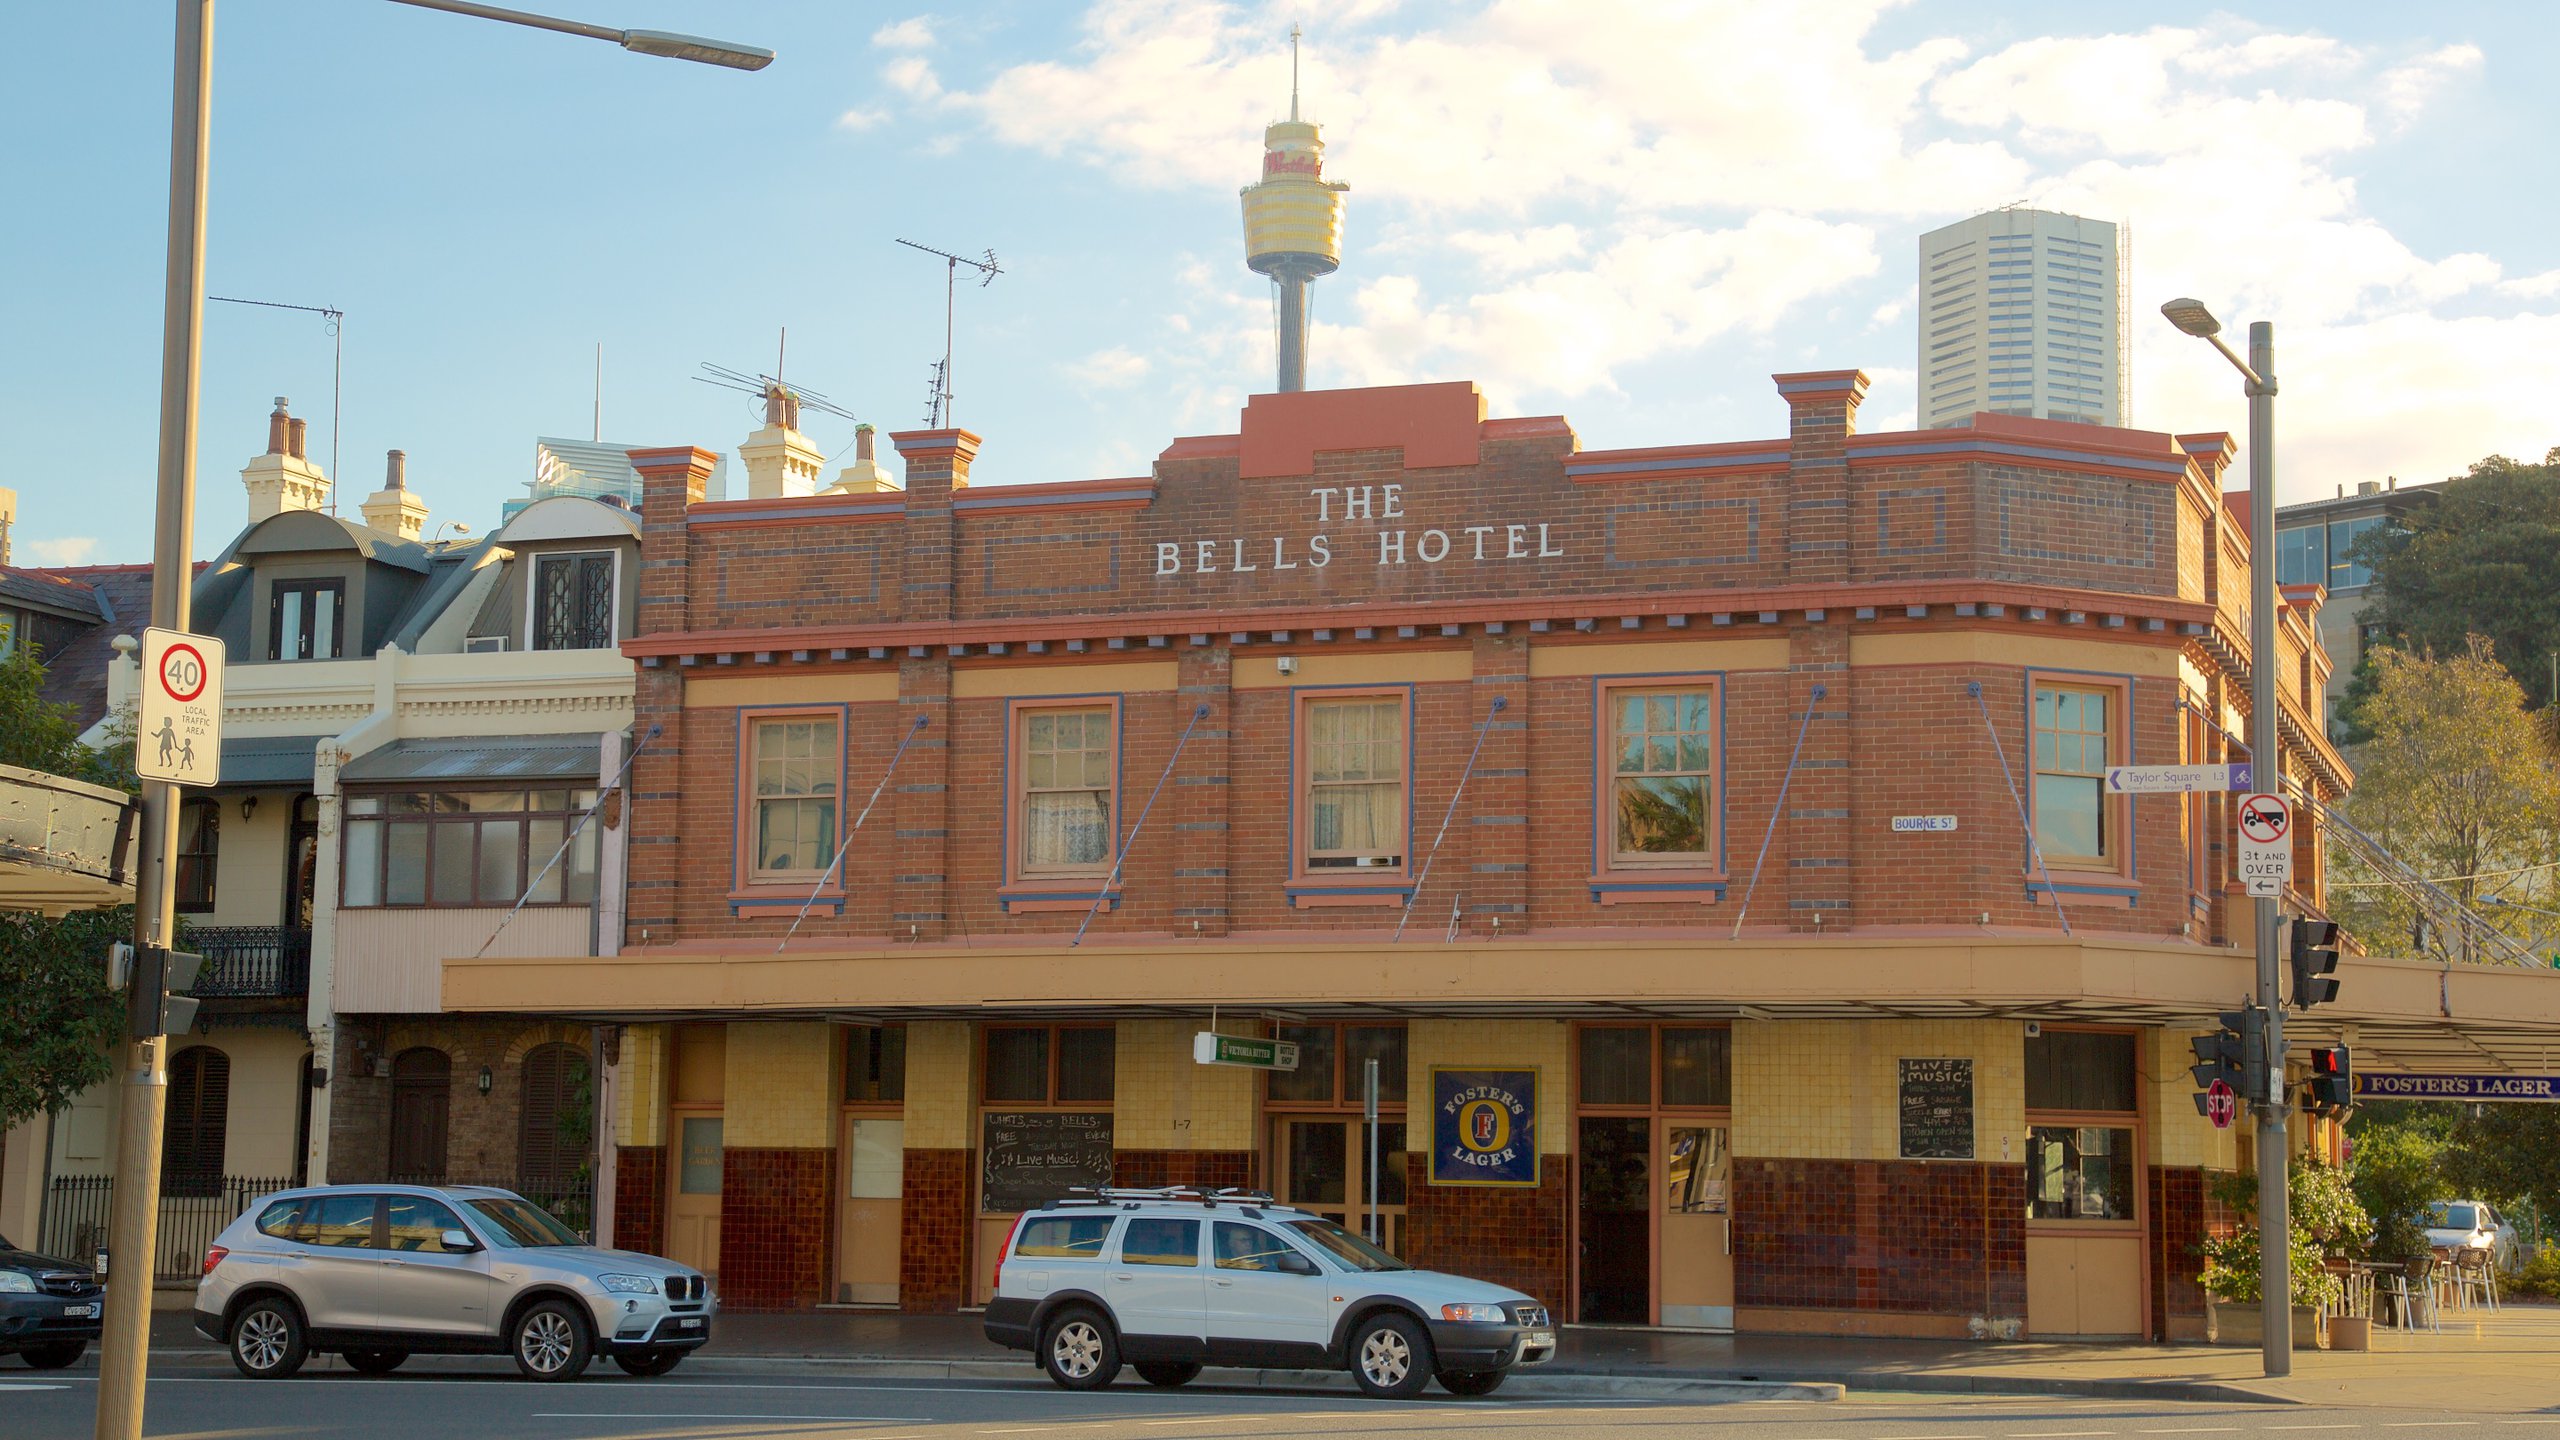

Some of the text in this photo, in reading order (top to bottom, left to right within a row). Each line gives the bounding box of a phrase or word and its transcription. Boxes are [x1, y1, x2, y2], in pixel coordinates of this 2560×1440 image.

[1310, 484, 1404, 522] THE
[1156, 523, 1564, 575] BELLS HOTEL
[168, 660, 198, 686] 40
[185, 706, 208, 717] LOCAL
[182, 715, 211, 727] TRAFFIC
[185, 726, 205, 736] AREA
[2127, 771, 2161, 785] Taylor
[2164, 771, 2201, 784] Square
[1895, 818, 1937, 829] BOURKE
[2264, 852, 2286, 860] AND
[2245, 864, 2284, 874] OVER
[1228, 1045, 1253, 1057] VICTORIA
[1280, 1046, 1295, 1056] BOTTLE
[1281, 1056, 1292, 1065] SHOP
[1909, 1060, 1953, 1071] LIVE
[1907, 1071, 1962, 1082] MUSIC
[2371, 1077, 2552, 1095] FOSTER'S LAGER
[1444, 1086, 1525, 1115] FOSTER'S
[1903, 1096, 1925, 1105] FREE
[2209, 1094, 2232, 1113] STOP
[989, 1114, 1025, 1126] WHATS
[1173, 1119, 1191, 1130] 1-7
[996, 1131, 1017, 1143] FREE
[1452, 1145, 1517, 1166] LAGER
